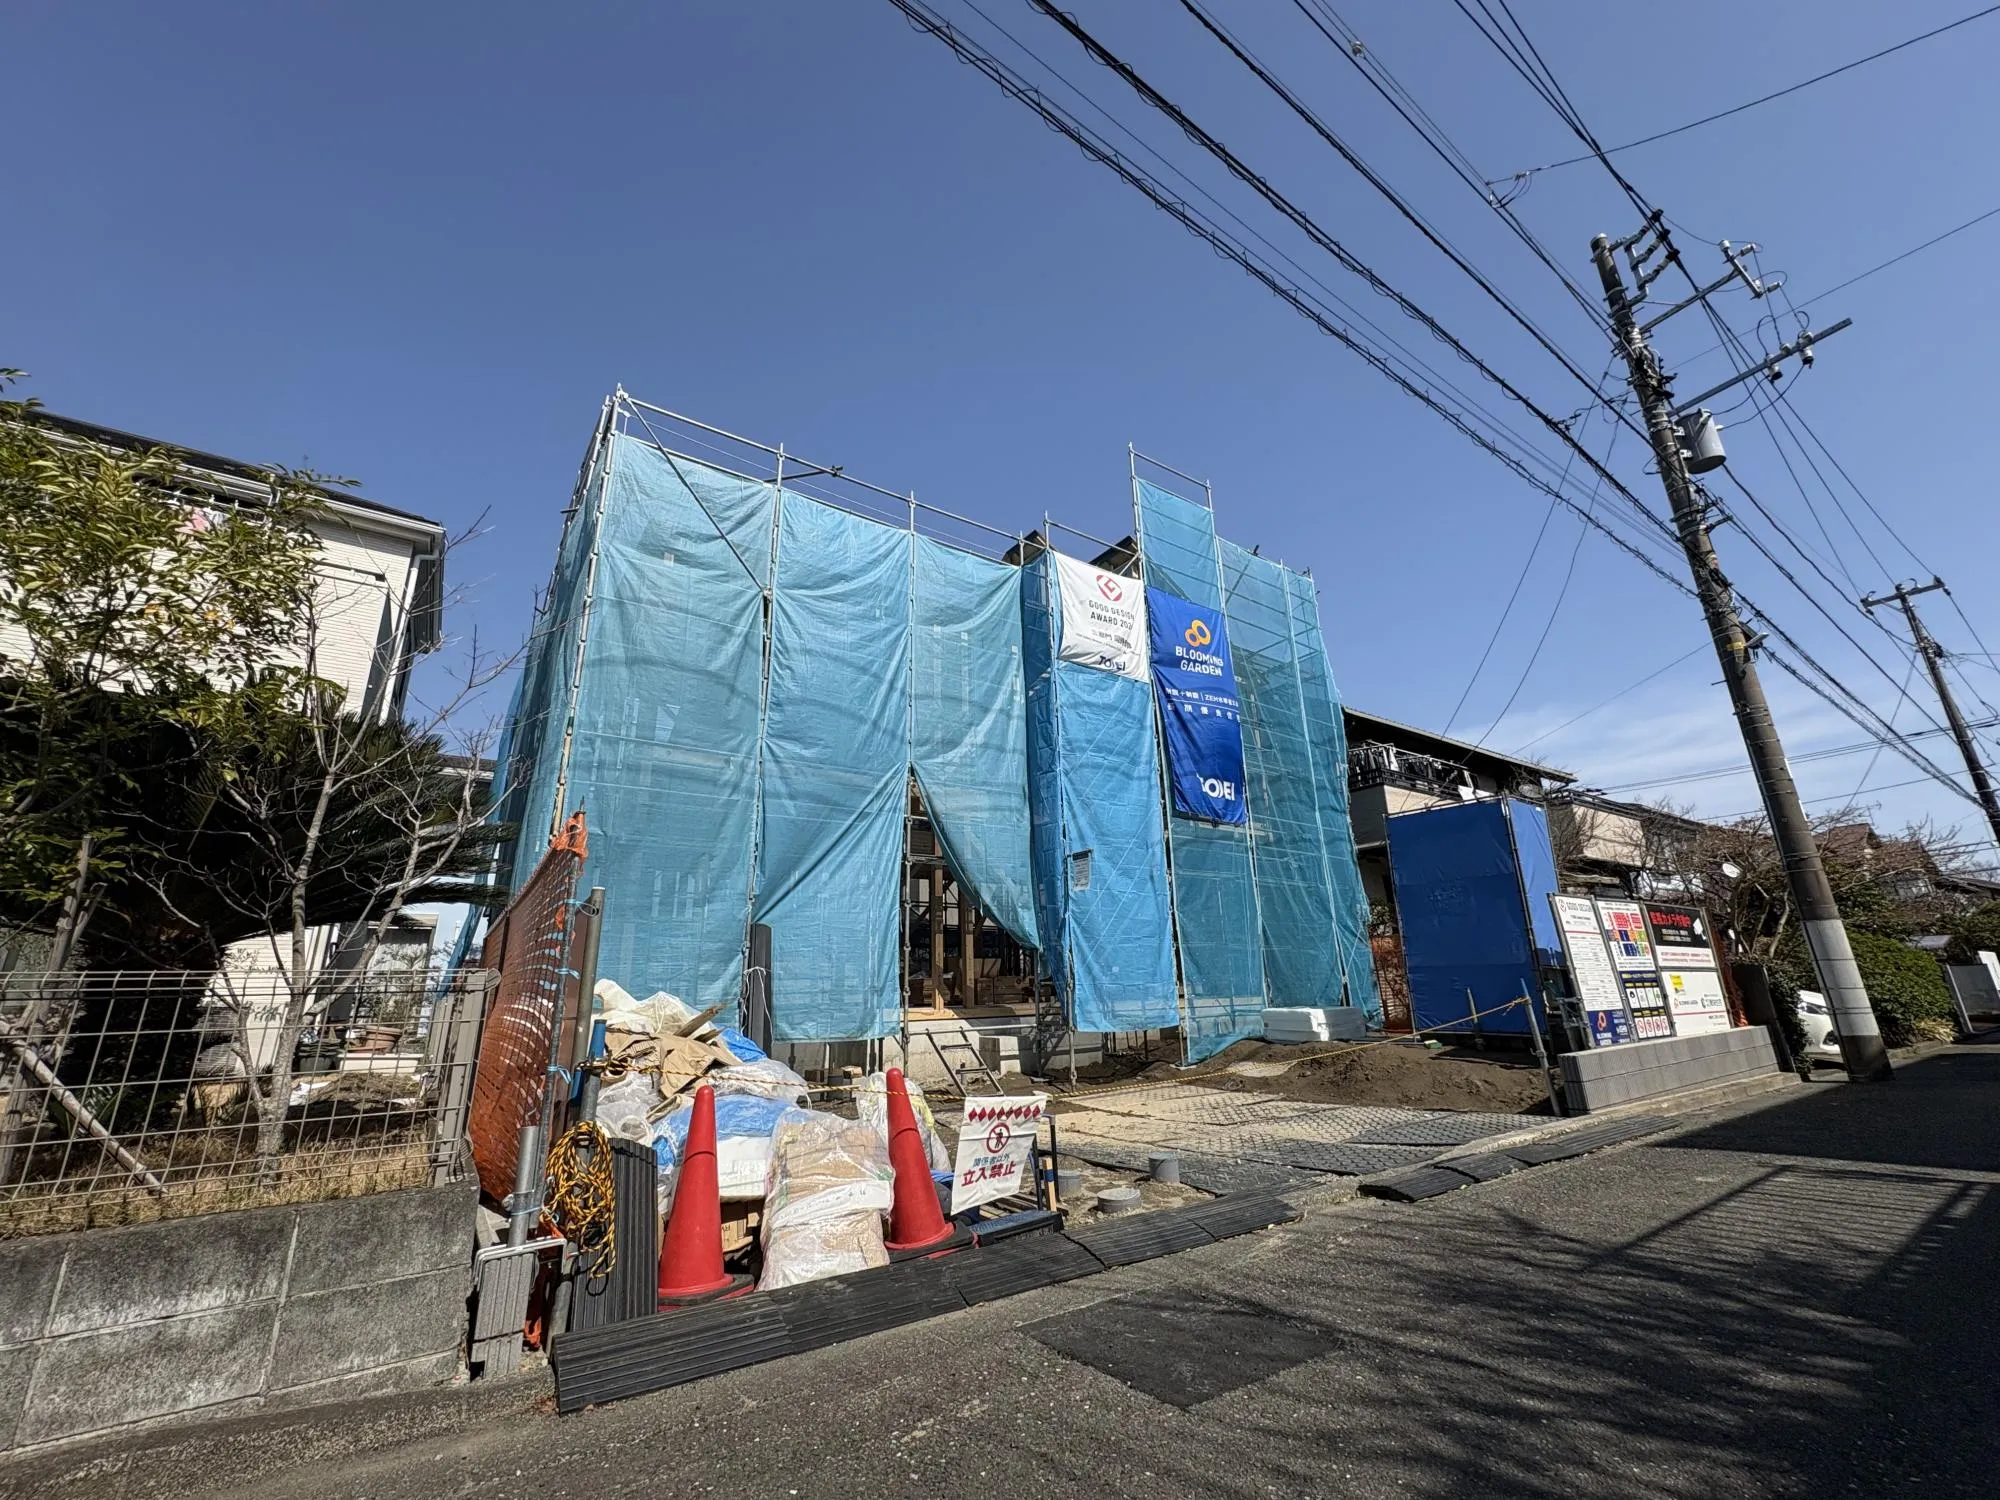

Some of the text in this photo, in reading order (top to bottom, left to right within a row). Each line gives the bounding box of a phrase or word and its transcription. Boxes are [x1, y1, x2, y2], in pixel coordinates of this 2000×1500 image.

[1088, 600, 1135, 621] GOOD DESIGN
[1090, 611, 1118, 626] AWARD
[1175, 645, 1224, 667] BLOOMING
[1180, 659, 1223, 677] GARDEN
[972, 1152, 1010, 1168] 関係者以外
[961, 1160, 1017, 1187] 立入禁止
